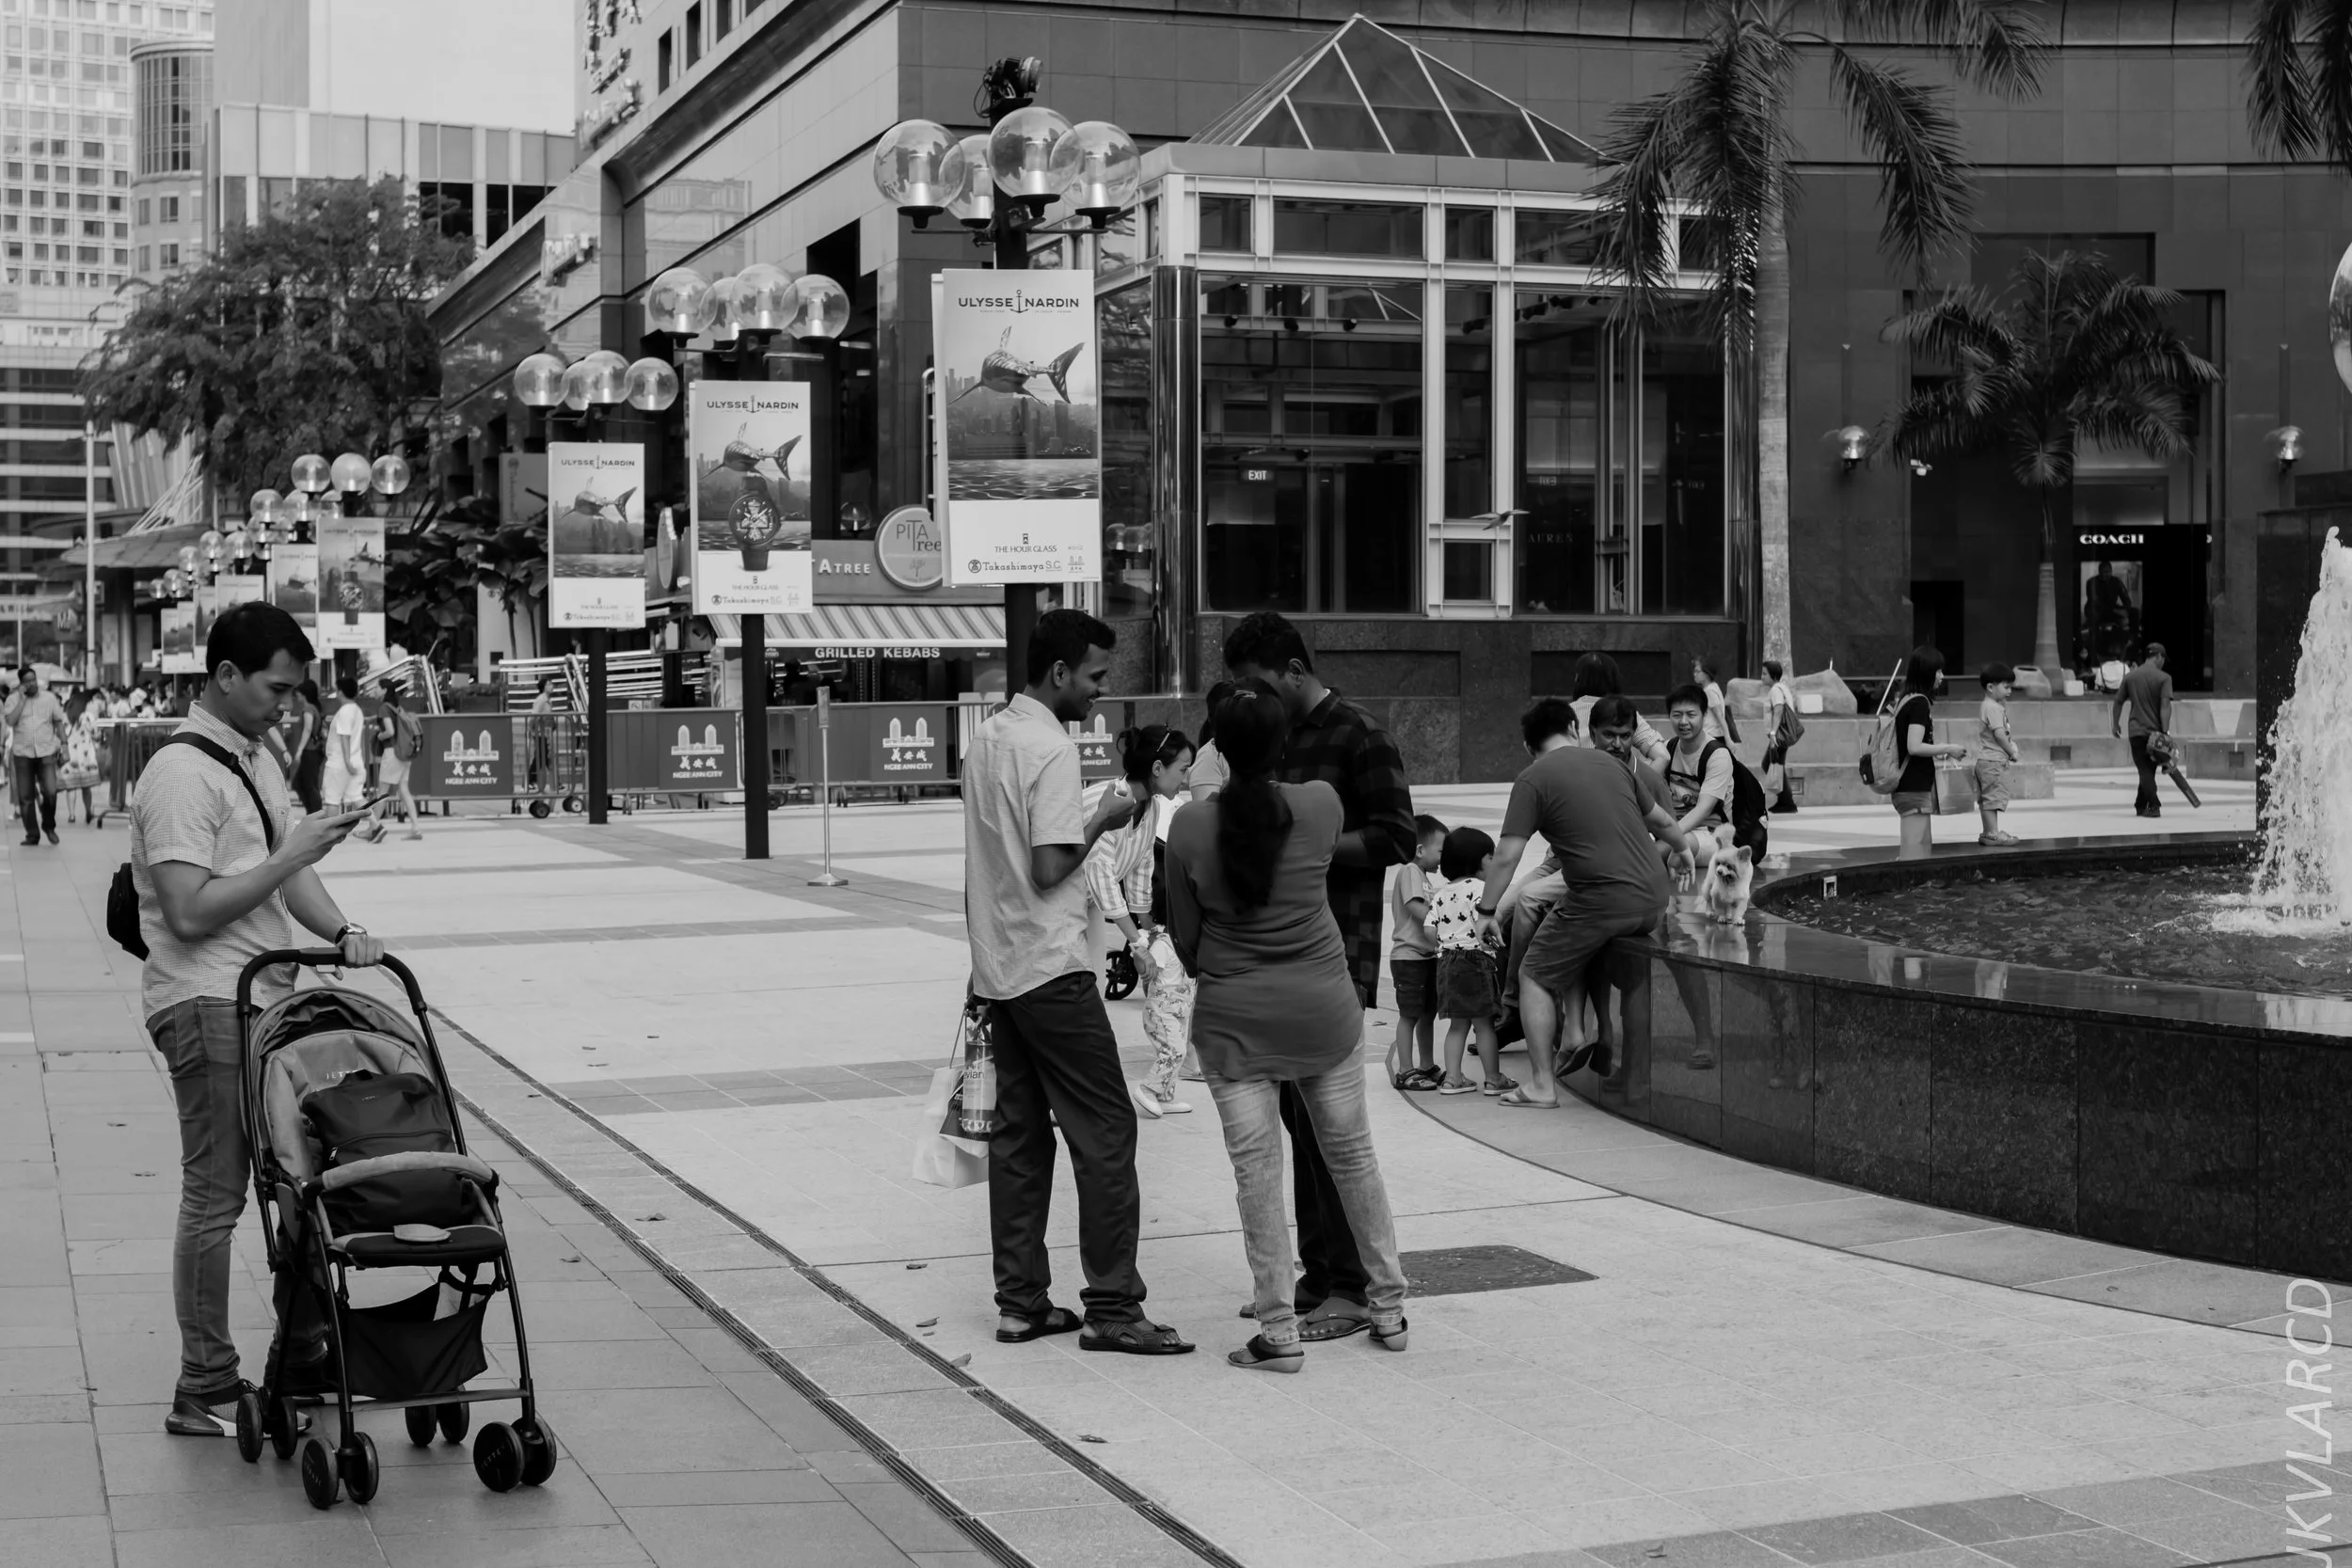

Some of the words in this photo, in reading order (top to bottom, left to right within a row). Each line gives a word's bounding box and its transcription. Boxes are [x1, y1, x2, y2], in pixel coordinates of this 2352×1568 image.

[958, 297, 1013, 308] ULYSSE
[1025, 298, 1079, 308] NARDIN
[1248, 469, 1267, 481] EXIT
[897, 520, 929, 551] PITA
[2079, 533, 2144, 545] COACH
[982, 562, 1044, 572] Takashimaya
[815, 647, 876, 658] GRILLED
[883, 647, 941, 658] KEBABS
